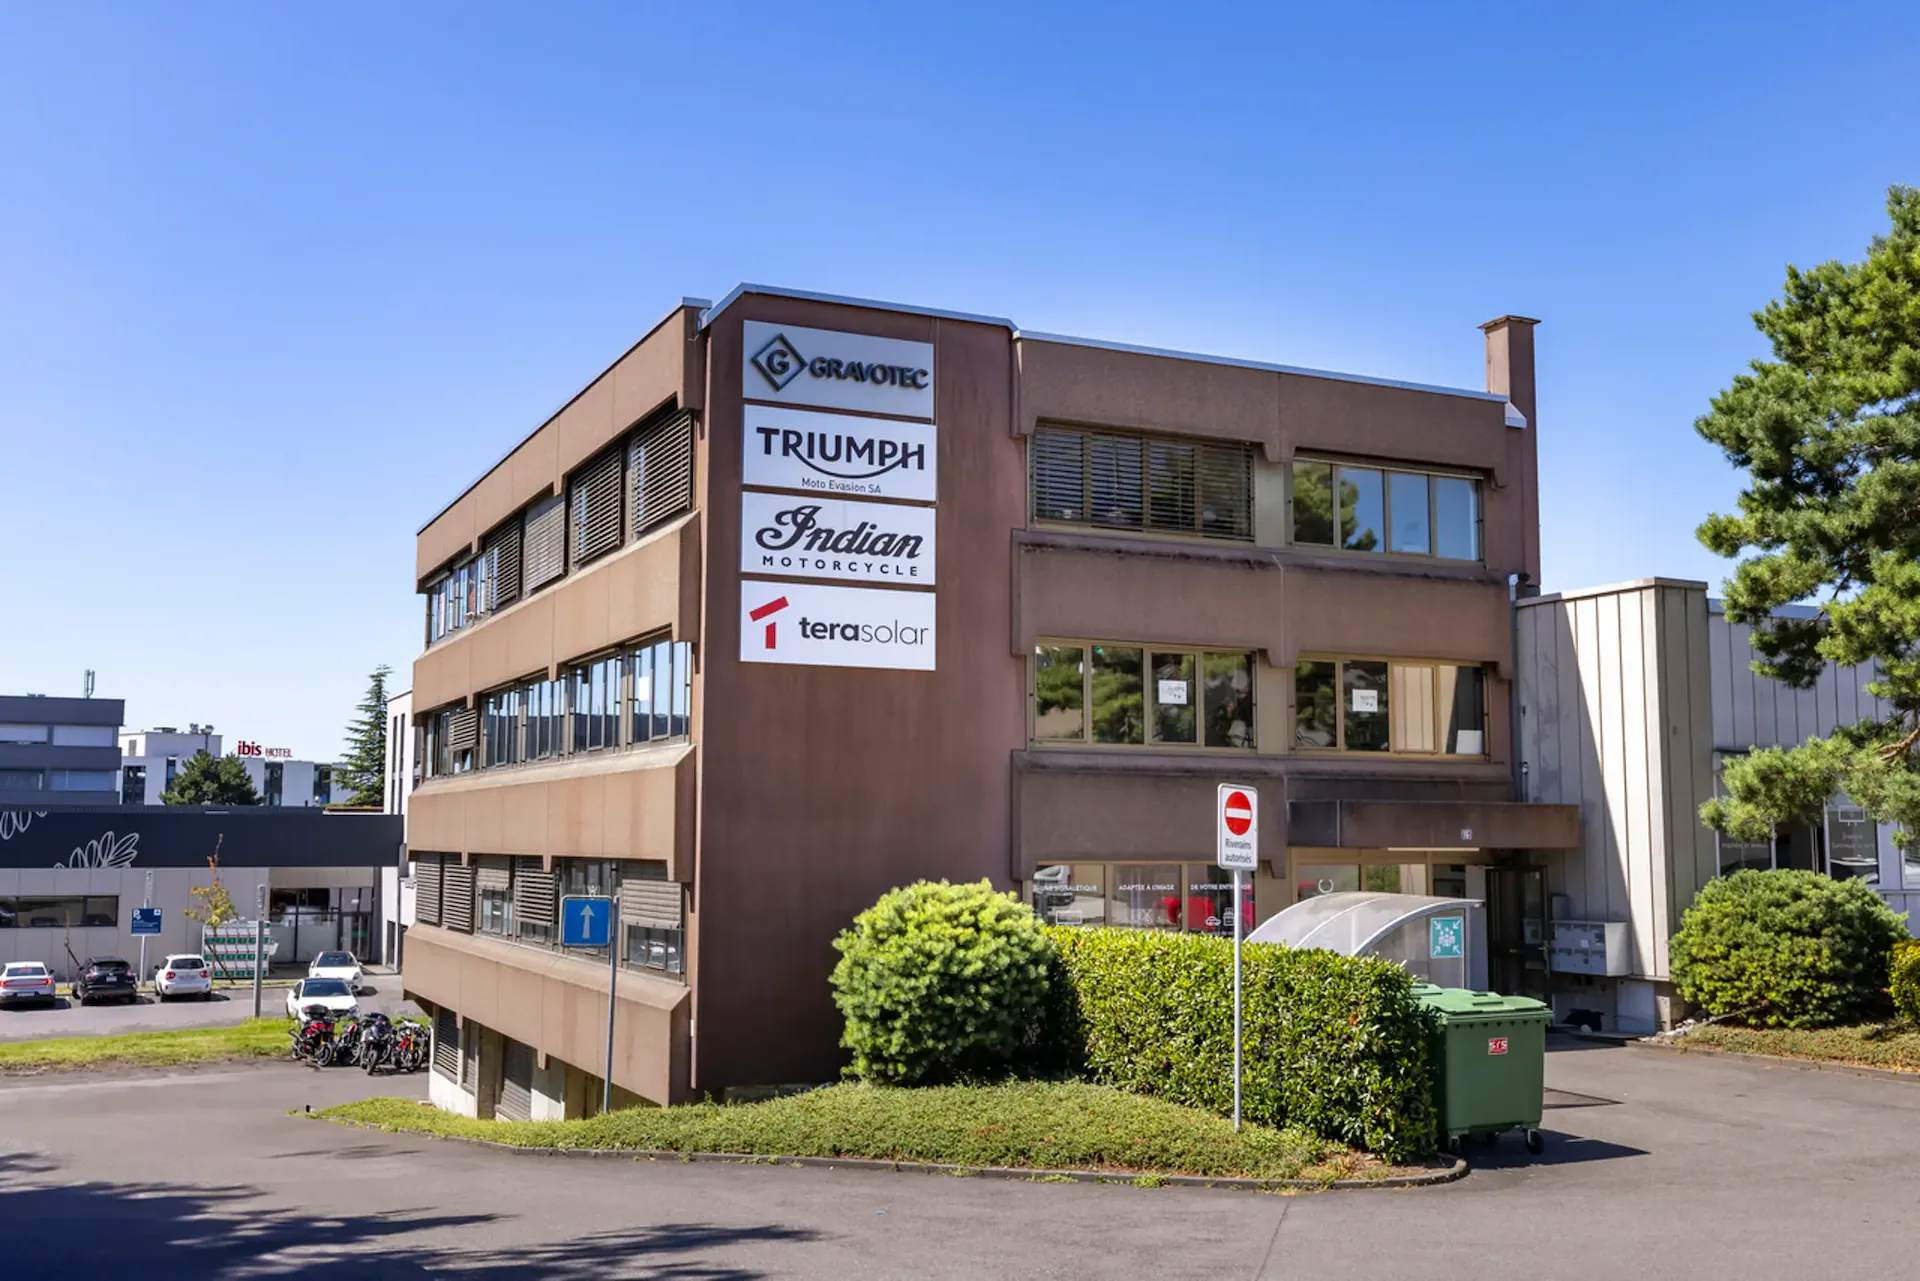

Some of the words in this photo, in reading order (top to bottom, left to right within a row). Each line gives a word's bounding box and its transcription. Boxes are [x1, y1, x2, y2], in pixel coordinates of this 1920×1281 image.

[766, 349, 790, 375] G
[808, 356, 929, 389] GRAVOTEC
[756, 426, 925, 479] TRIUMPH
[801, 477, 826, 489] Moto
[828, 480, 866, 492] Evasion
[868, 484, 882, 494] SA
[755, 504, 924, 559] Indian
[762, 555, 918, 577] MOTORCYCLE
[798, 617, 929, 646] terasolar
[238, 741, 262, 756] ibis
[265, 748, 292, 757] HOTEL
[1225, 838, 1252, 850] Riverains
[1225, 853, 1252, 864] autorisés
